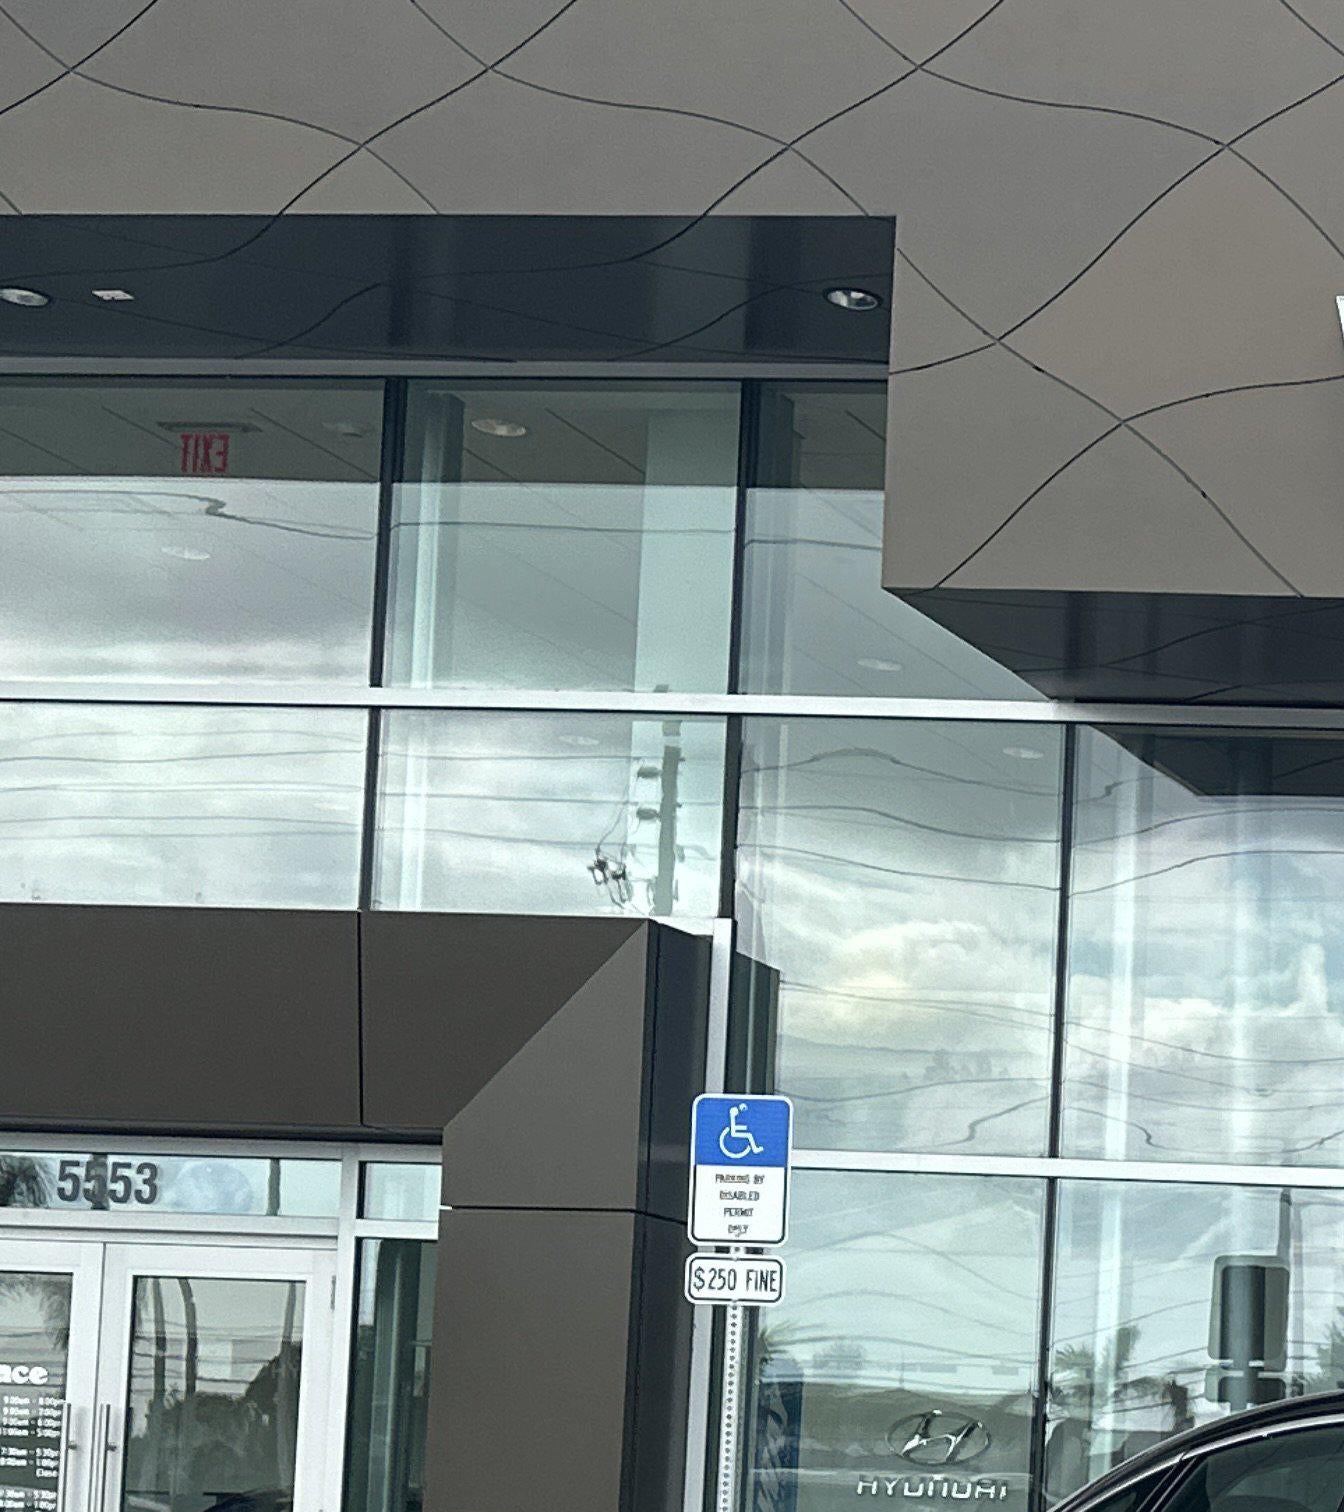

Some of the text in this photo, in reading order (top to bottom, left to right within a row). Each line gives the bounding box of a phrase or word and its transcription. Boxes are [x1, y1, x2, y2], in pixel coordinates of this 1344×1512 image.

[57, 1160, 158, 1205] 5553
[693, 1266, 778, 1293] $250 FINE
[856, 1476, 1007, 1500] HYUNDAI
